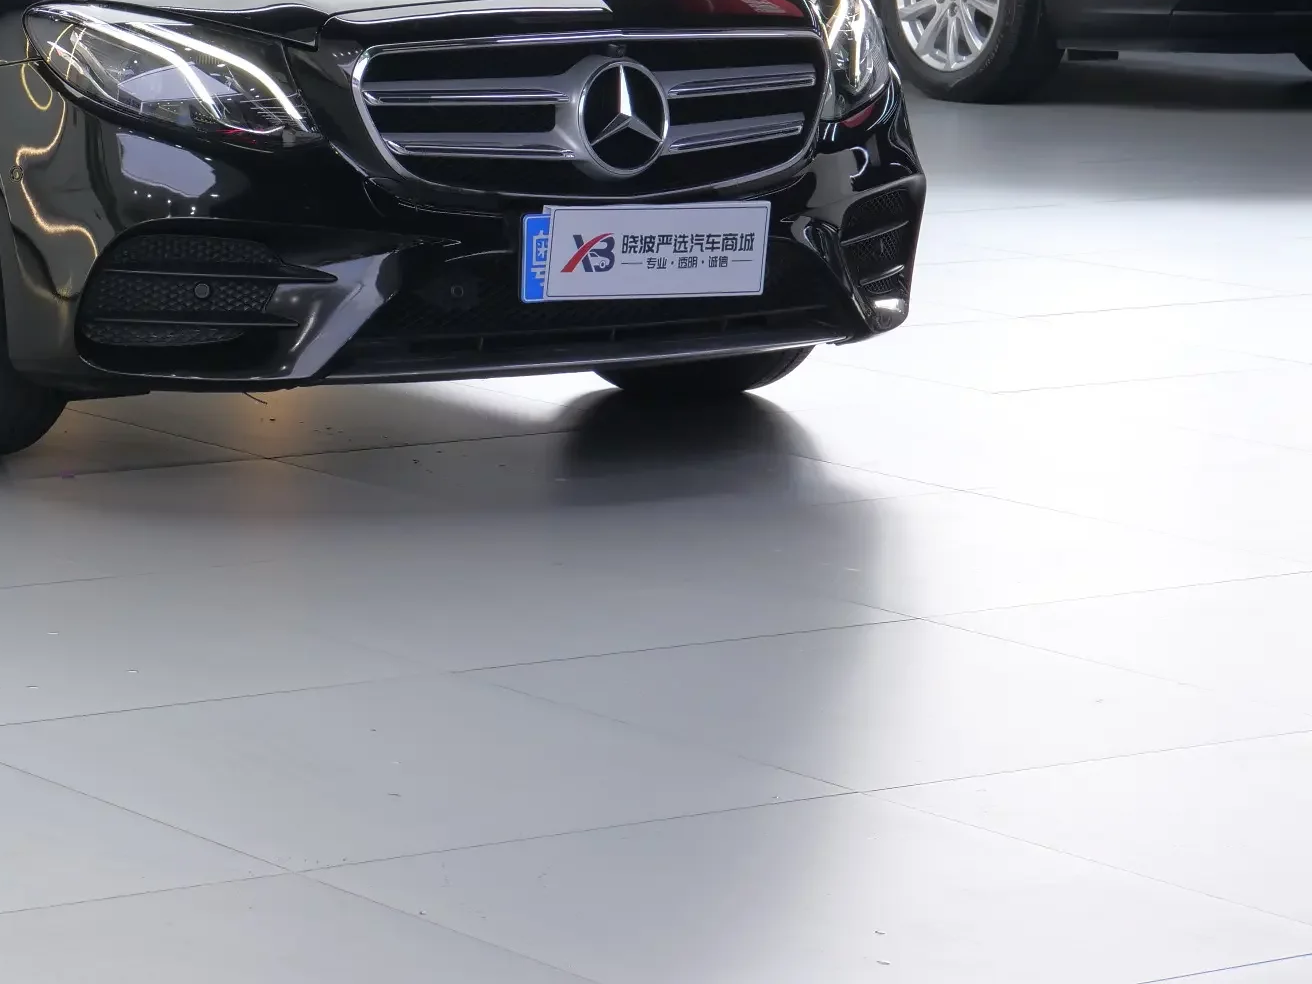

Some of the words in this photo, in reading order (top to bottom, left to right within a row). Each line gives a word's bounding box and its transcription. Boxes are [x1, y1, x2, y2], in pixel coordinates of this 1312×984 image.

[621, 232, 756, 254] 晓波严选汽车商城
